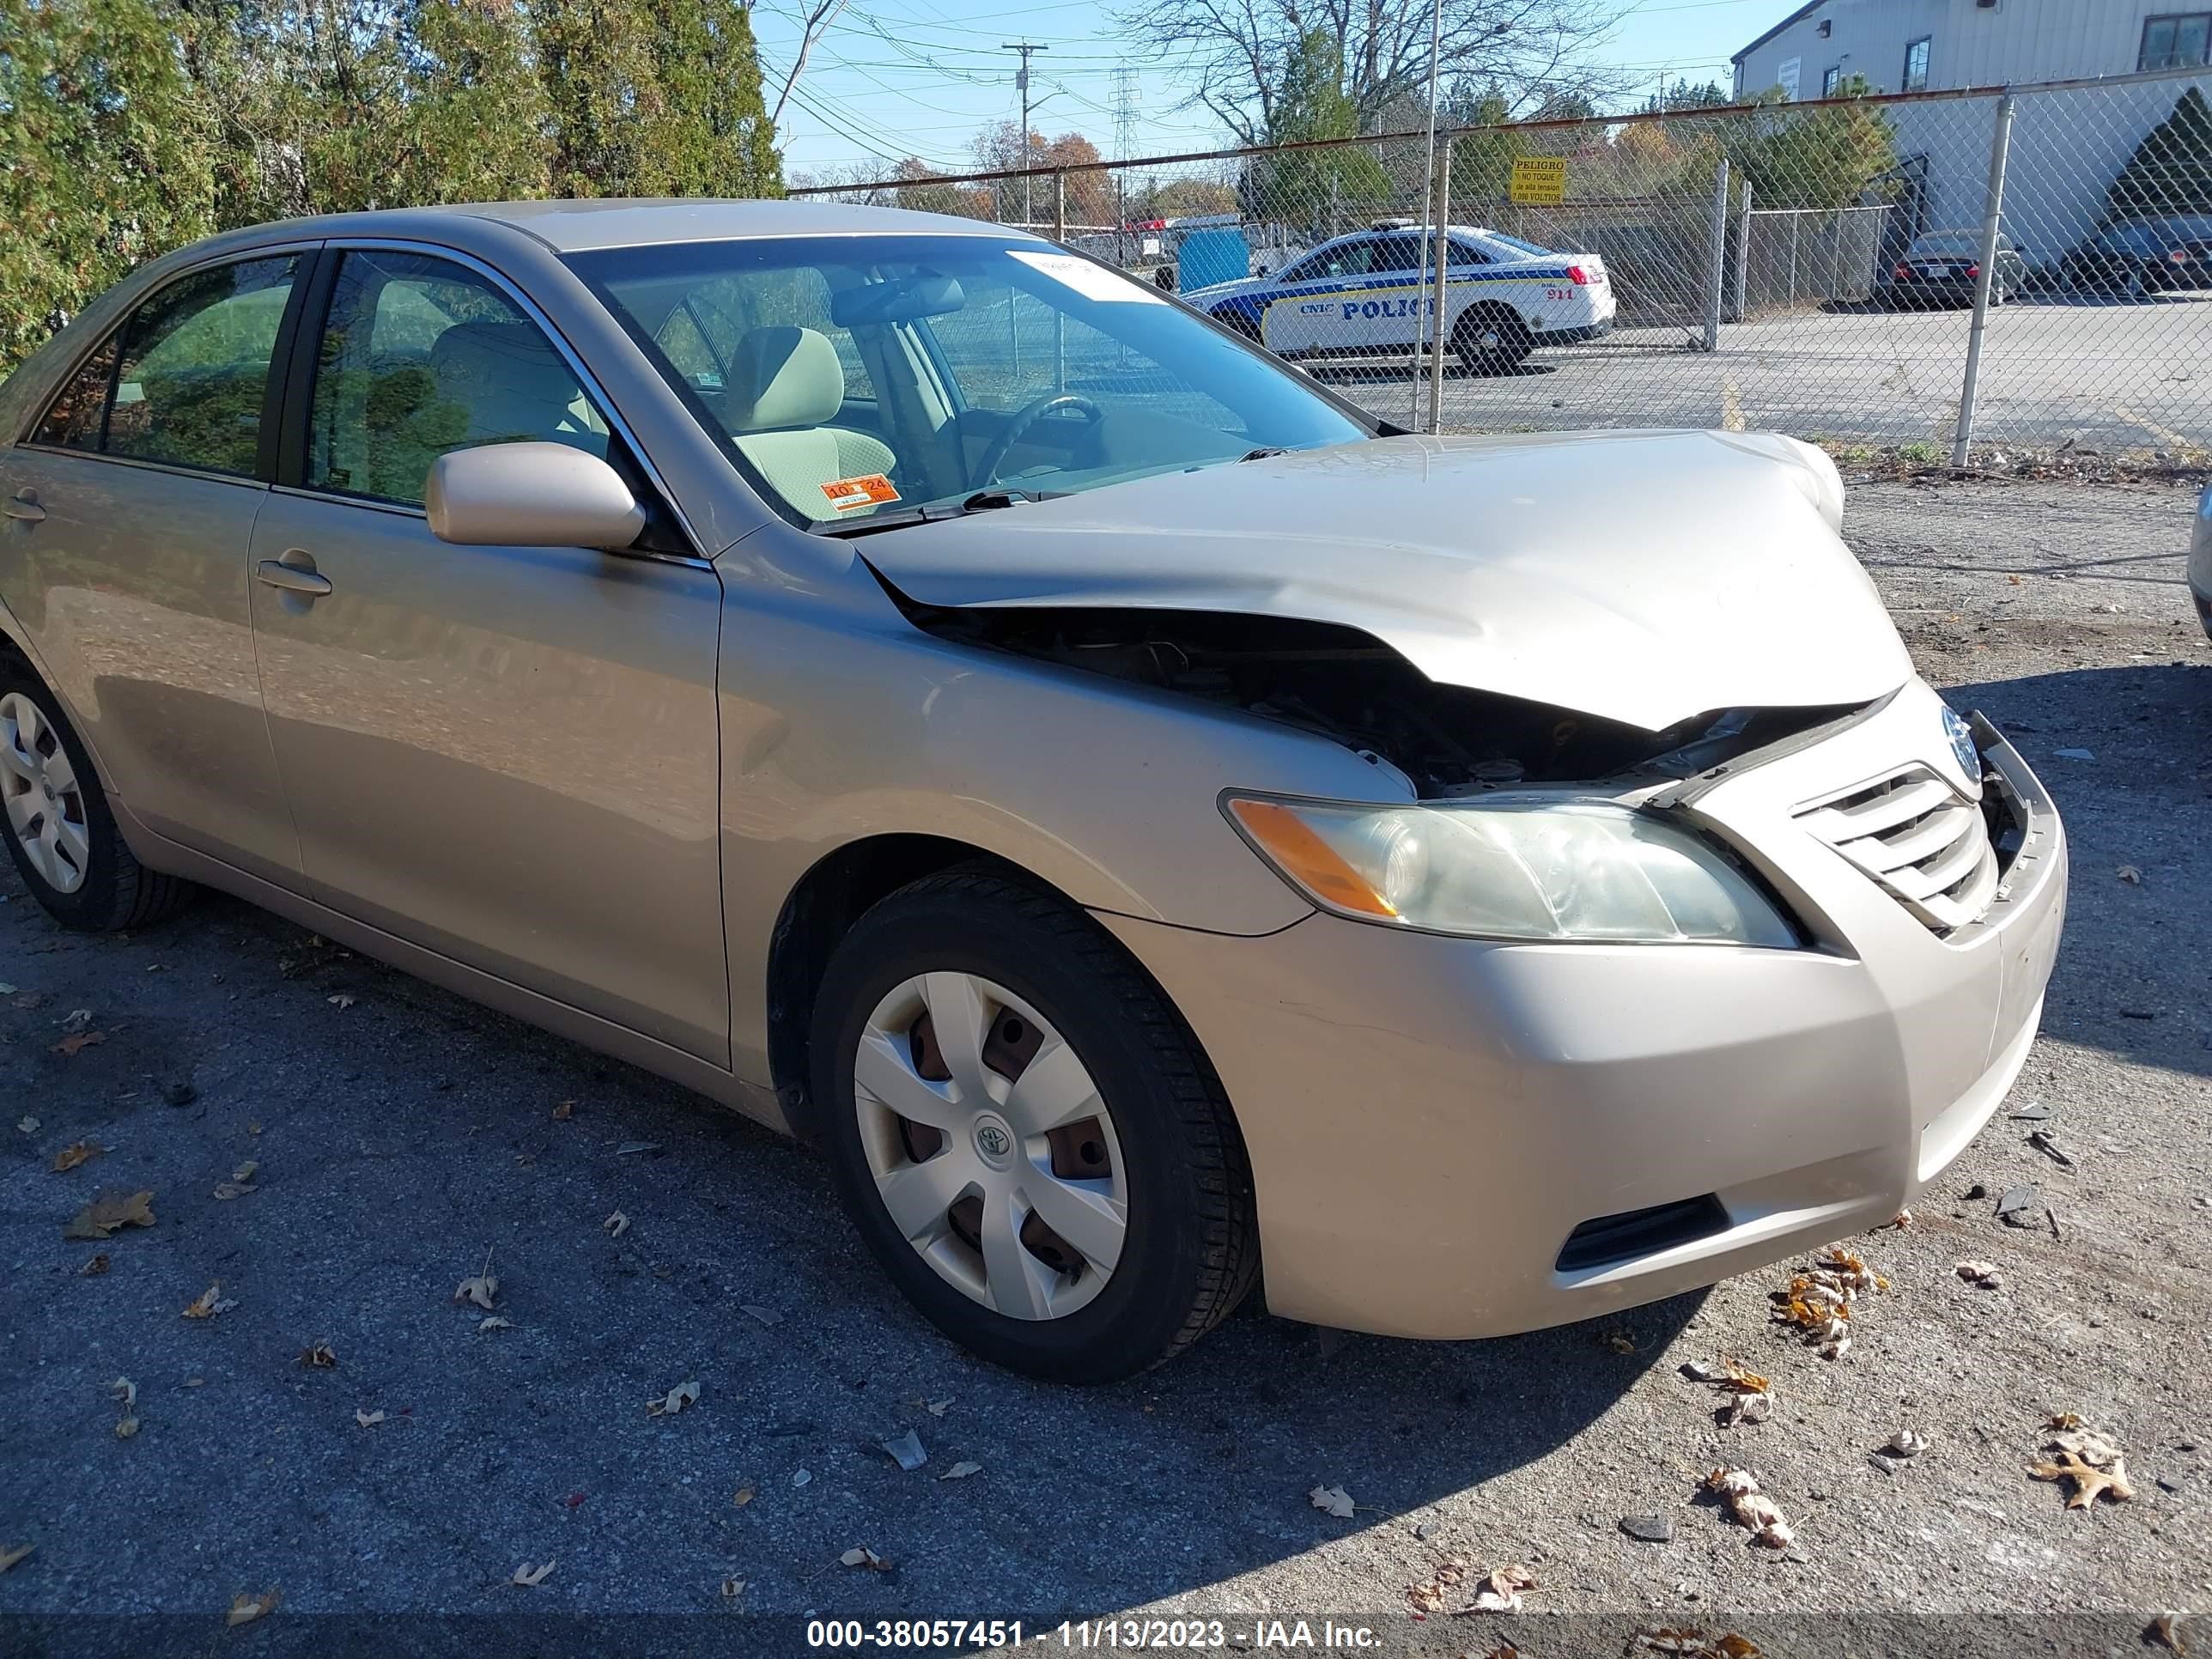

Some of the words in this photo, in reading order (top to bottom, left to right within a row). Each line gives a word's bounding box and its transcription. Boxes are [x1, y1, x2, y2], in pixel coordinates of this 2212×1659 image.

[1516, 161, 1564, 170] PELIGRO
[1547, 289, 1573, 300] 911
[830, 486, 849, 497] 10
[866, 479, 886, 491] 24
